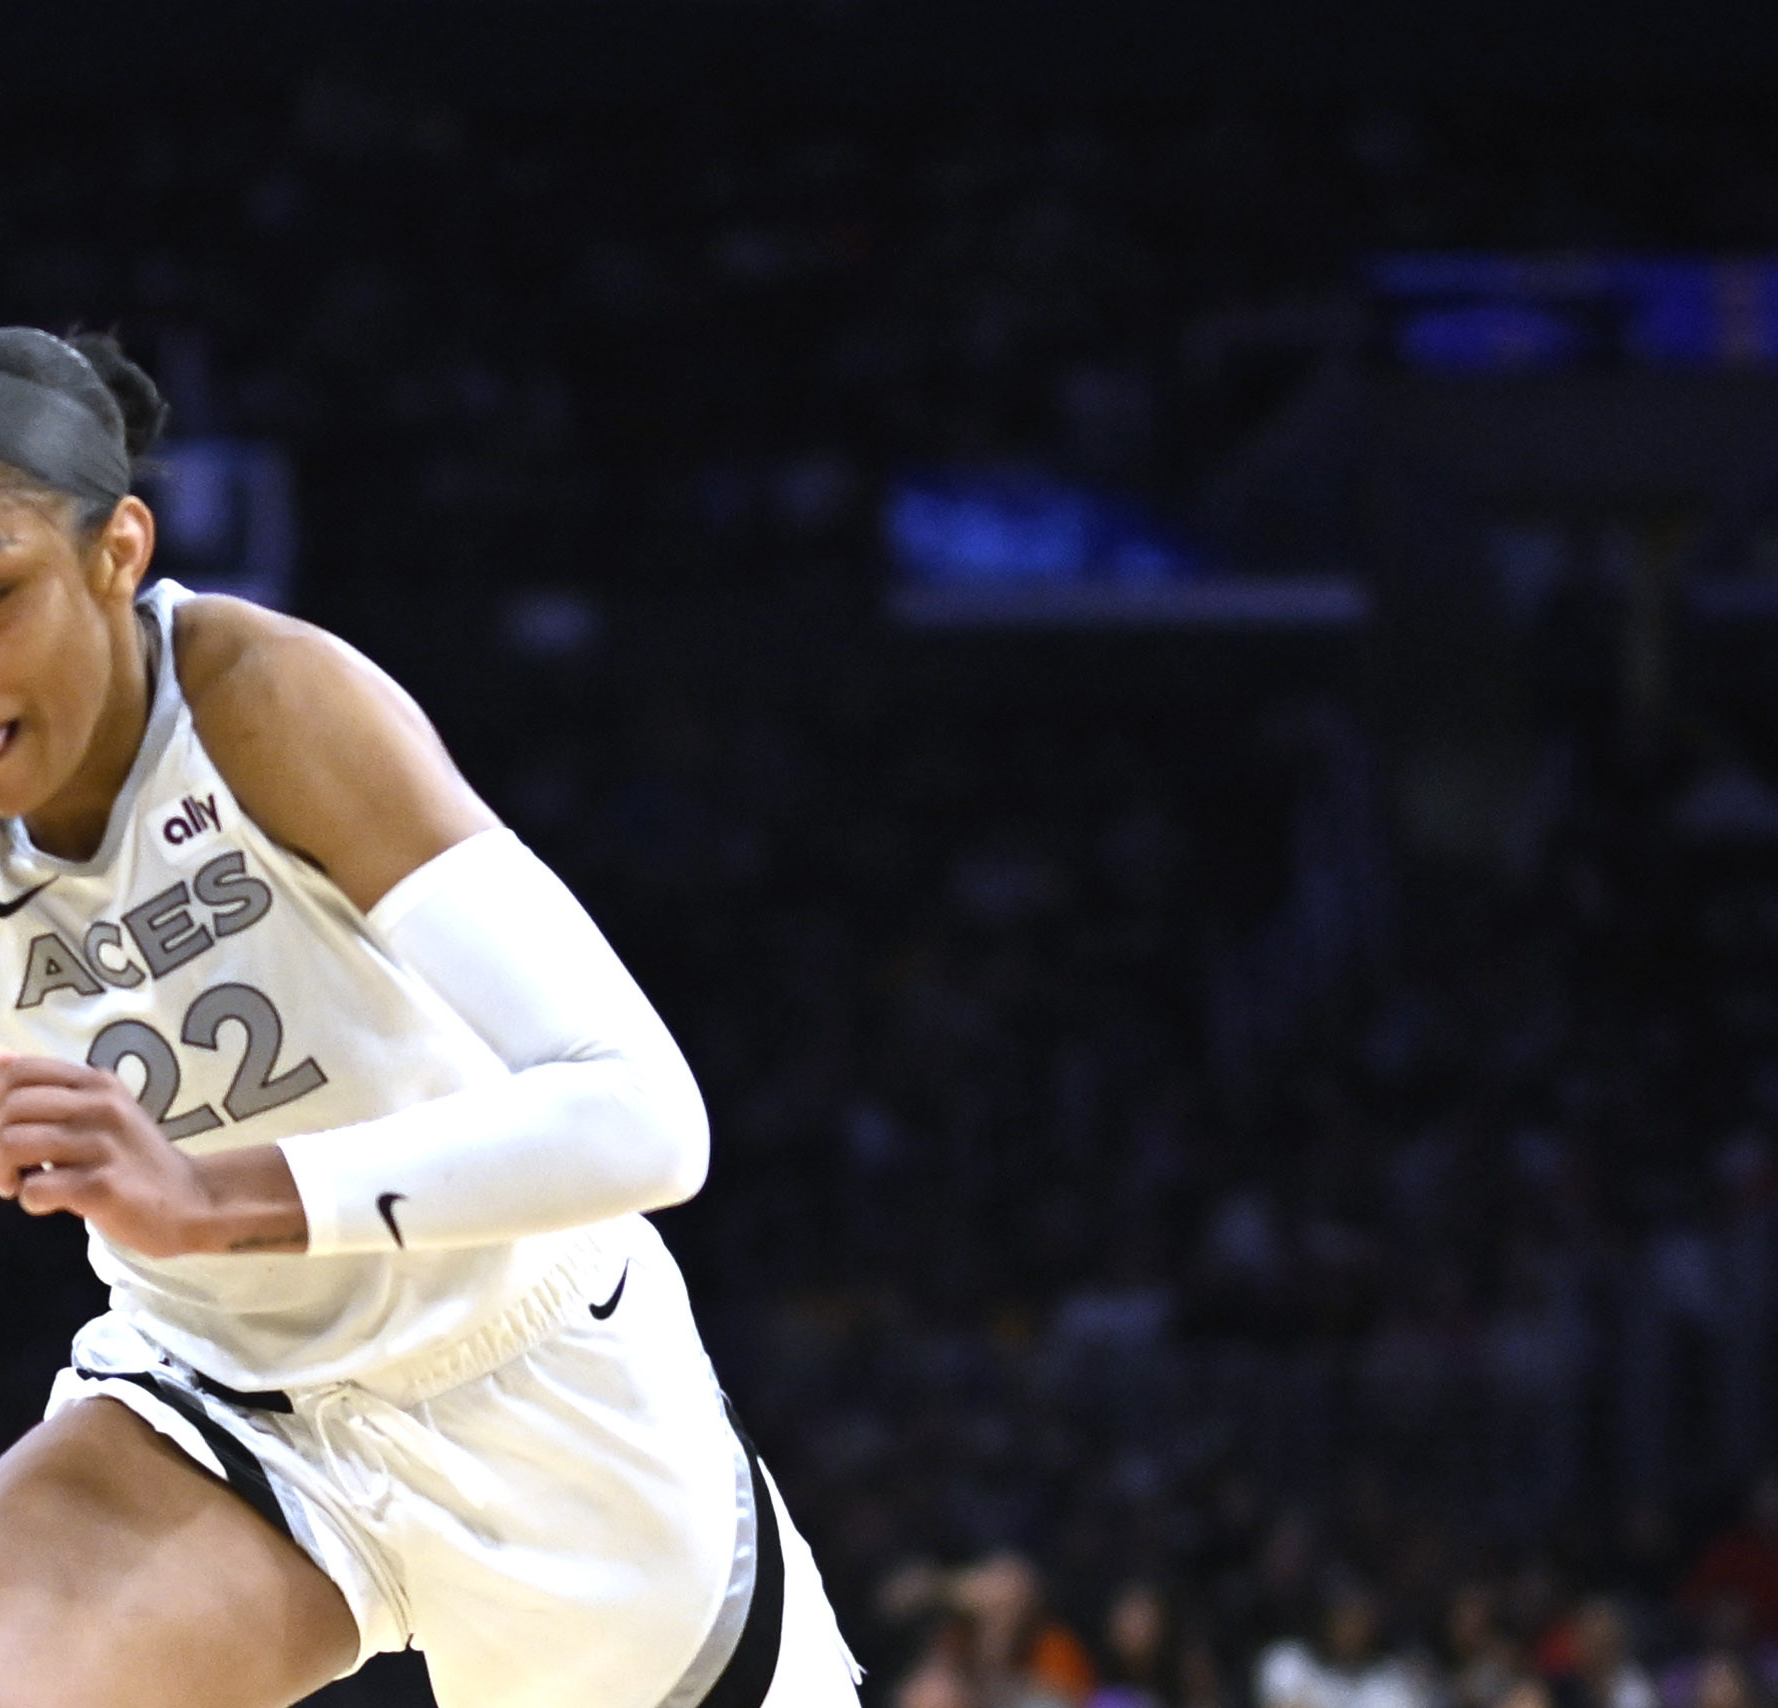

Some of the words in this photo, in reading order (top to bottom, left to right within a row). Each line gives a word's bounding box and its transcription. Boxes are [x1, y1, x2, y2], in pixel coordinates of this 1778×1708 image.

[163, 792, 222, 845] ally
[15, 849, 272, 1009] ACES
[86, 981, 328, 1141] 22
